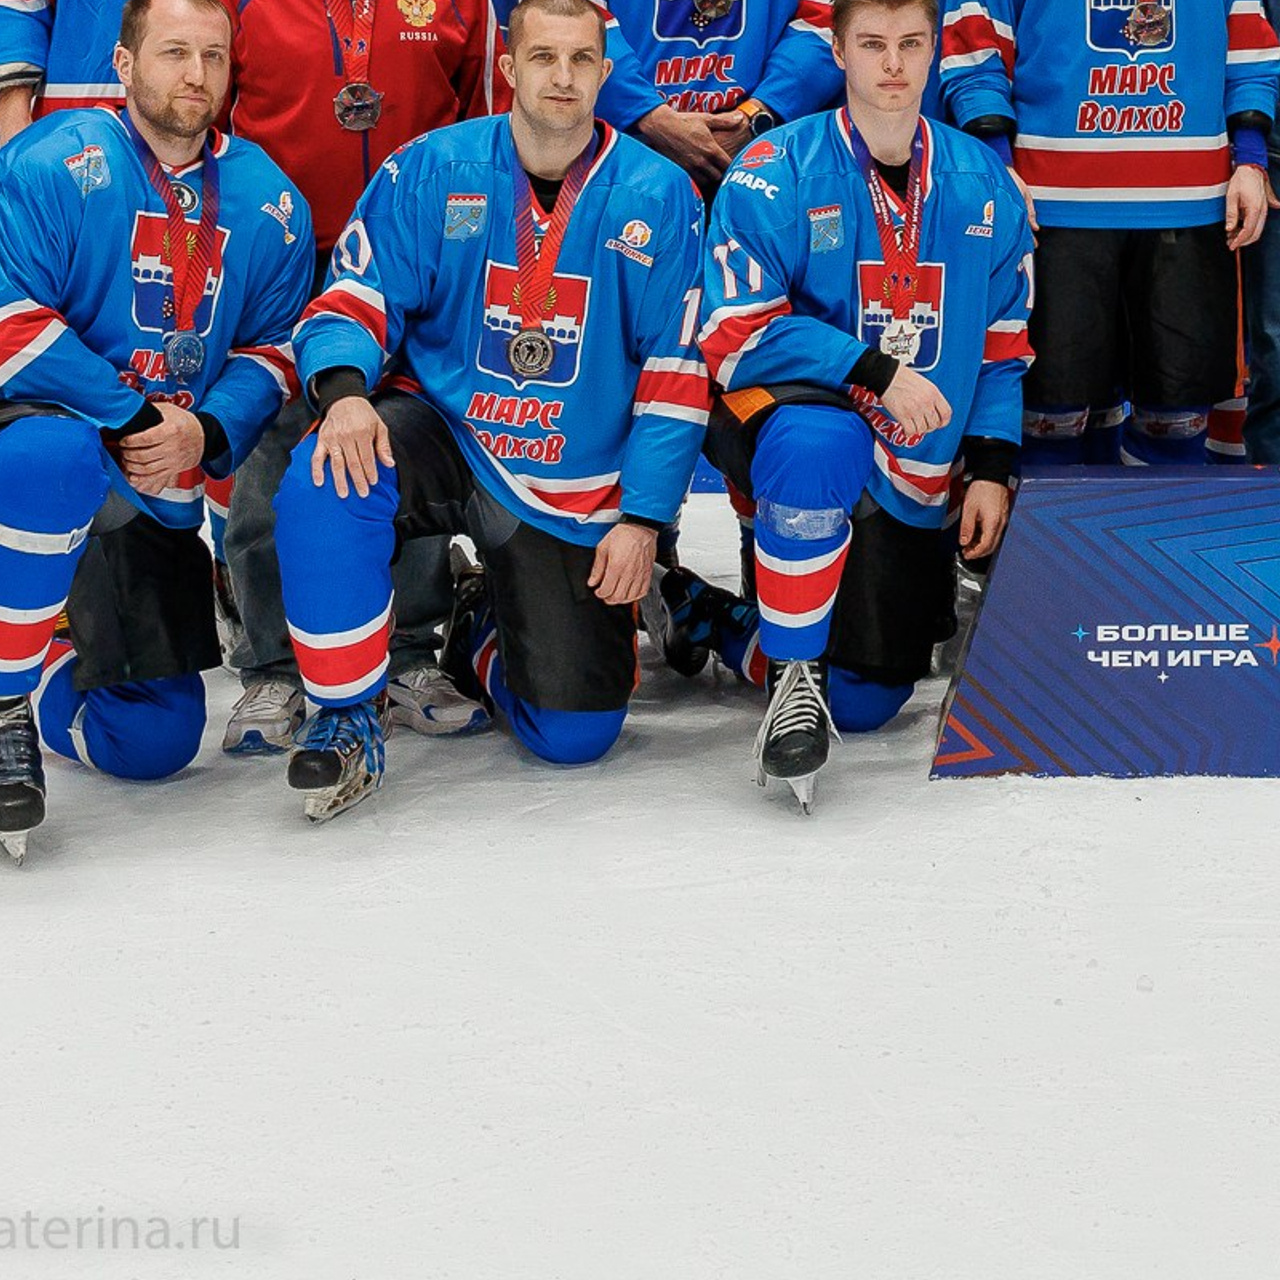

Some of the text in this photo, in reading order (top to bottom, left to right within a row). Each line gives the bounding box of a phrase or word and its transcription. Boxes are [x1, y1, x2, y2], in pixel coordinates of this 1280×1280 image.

[399, 30, 439, 42] RUSSIA
[655, 52, 737, 87] МАРС
[1087, 63, 1176, 96] МАРС
[465, 391, 564, 431] МАРС
[1096, 623, 1250, 641] БОЛЬШЕ
[1086, 649, 1260, 667] ЧЕМ ИГРА
